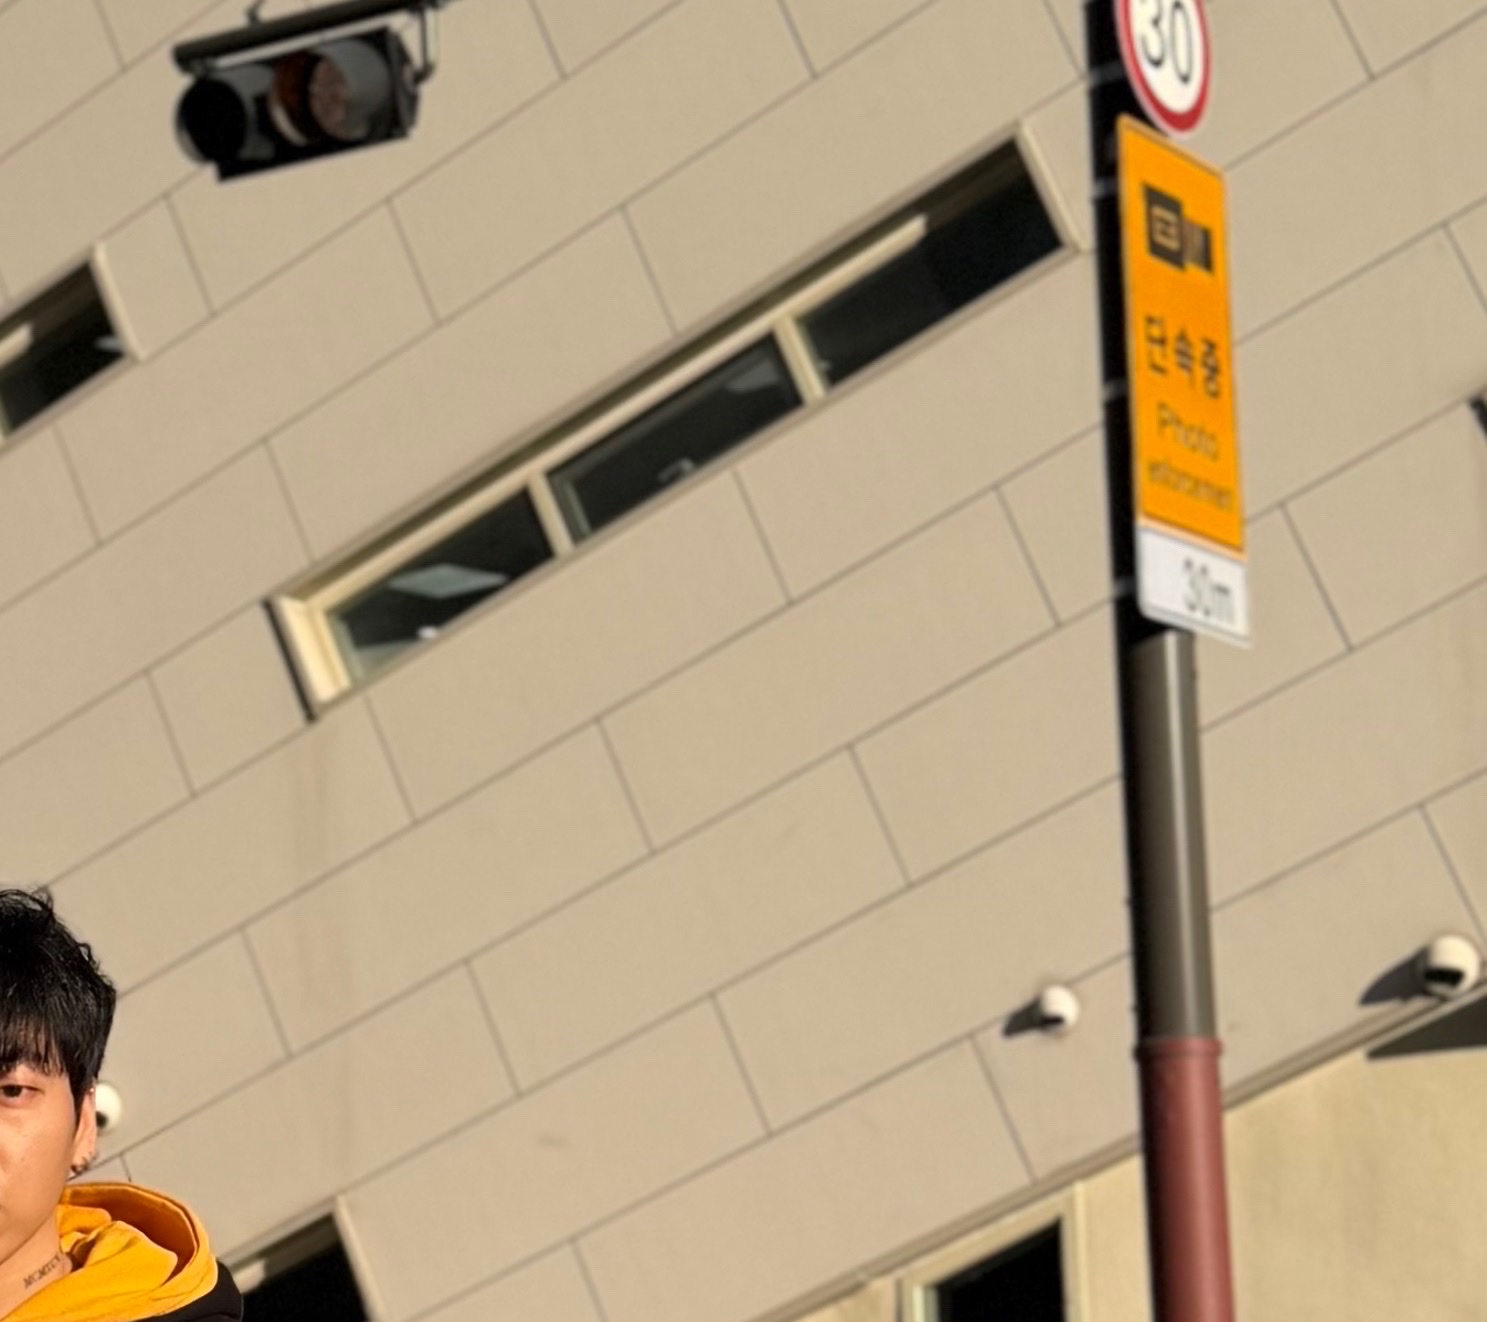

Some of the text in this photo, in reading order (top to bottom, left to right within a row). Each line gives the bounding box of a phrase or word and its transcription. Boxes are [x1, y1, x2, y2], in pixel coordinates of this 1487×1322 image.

[1139, 0, 1193, 85] 30
[1145, 314, 1221, 399] 단속중
[1157, 401, 1218, 462] Photo
[1183, 557, 1234, 624] 30m
